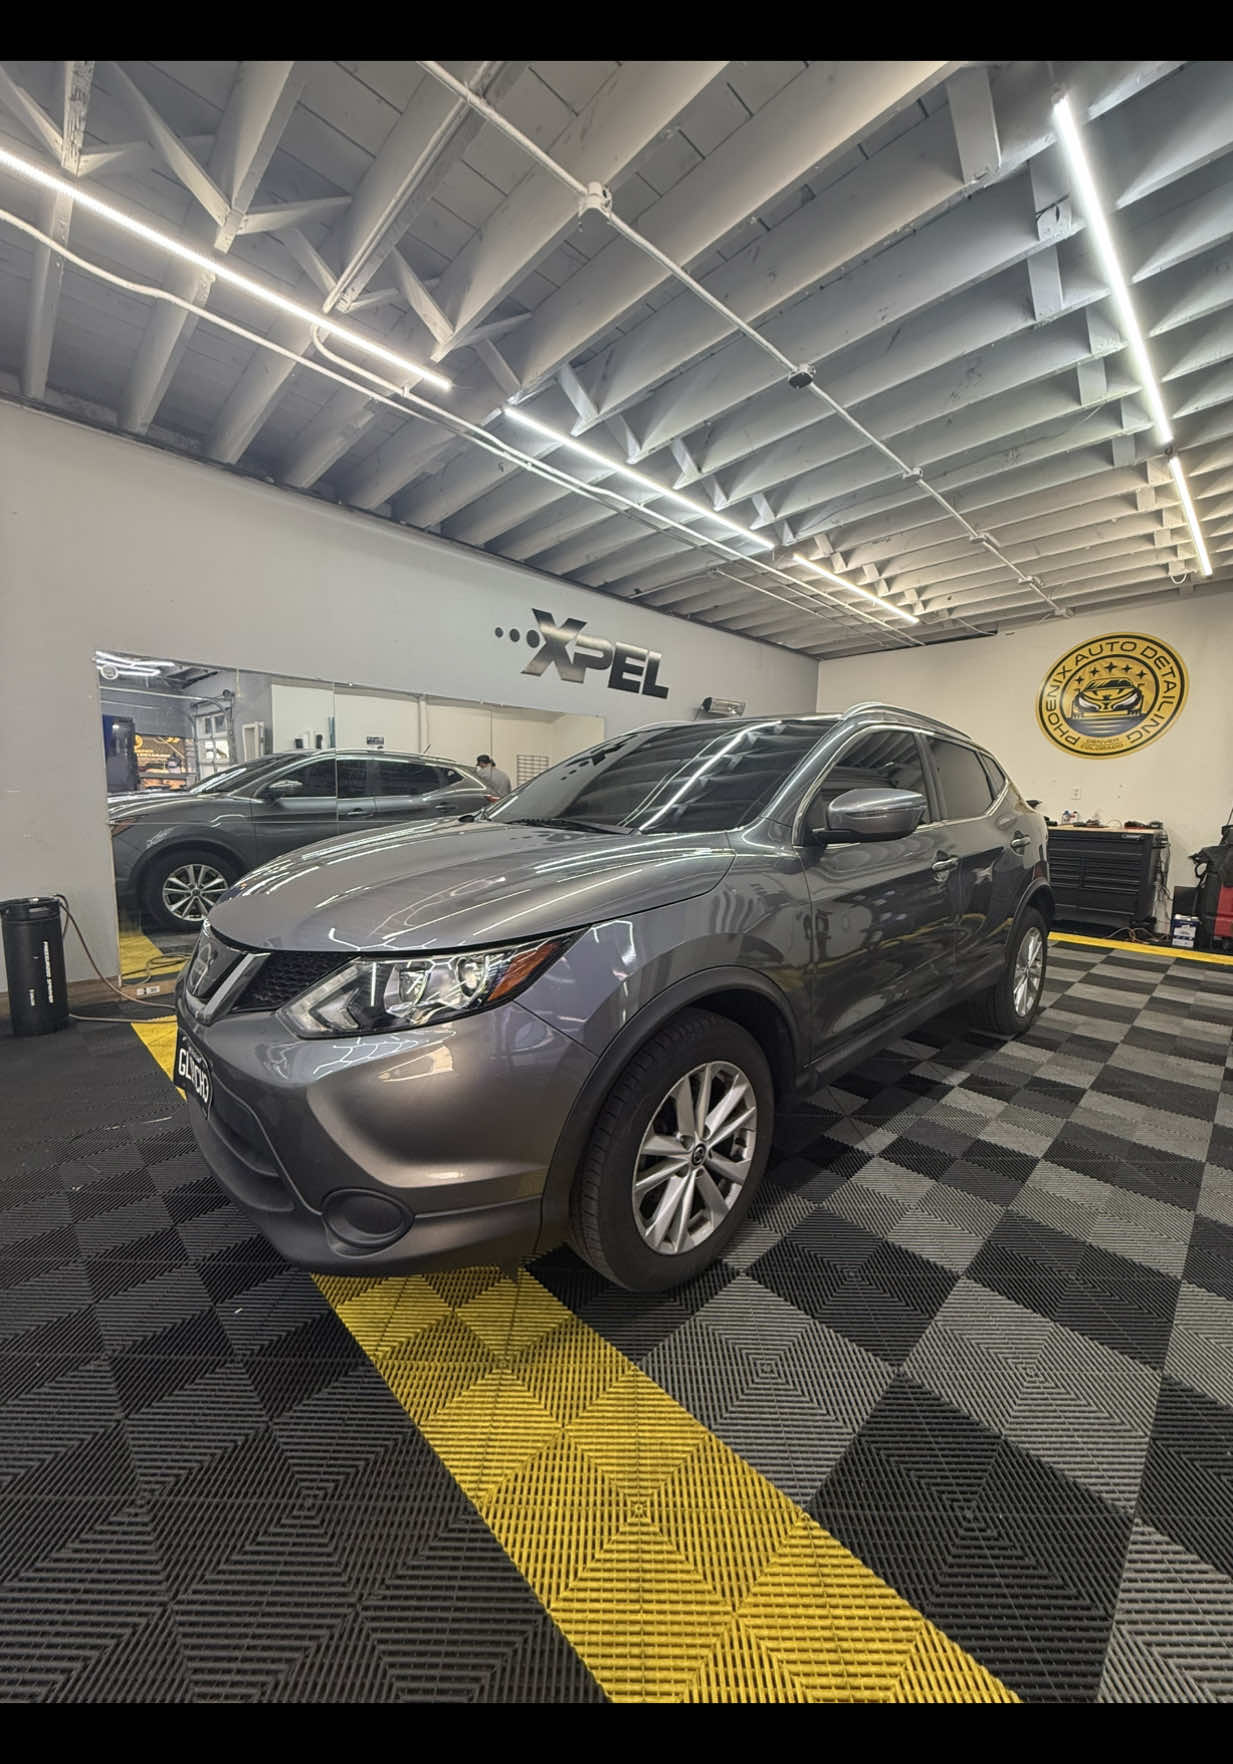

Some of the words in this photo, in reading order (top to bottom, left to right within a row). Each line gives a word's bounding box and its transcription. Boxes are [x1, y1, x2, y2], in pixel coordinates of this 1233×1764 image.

[520, 608, 669, 699] XPEL
[1046, 665, 1081, 746] PHOENIX
[1075, 641, 1137, 666] AUTO
[1127, 645, 1177, 744] DETAILING
